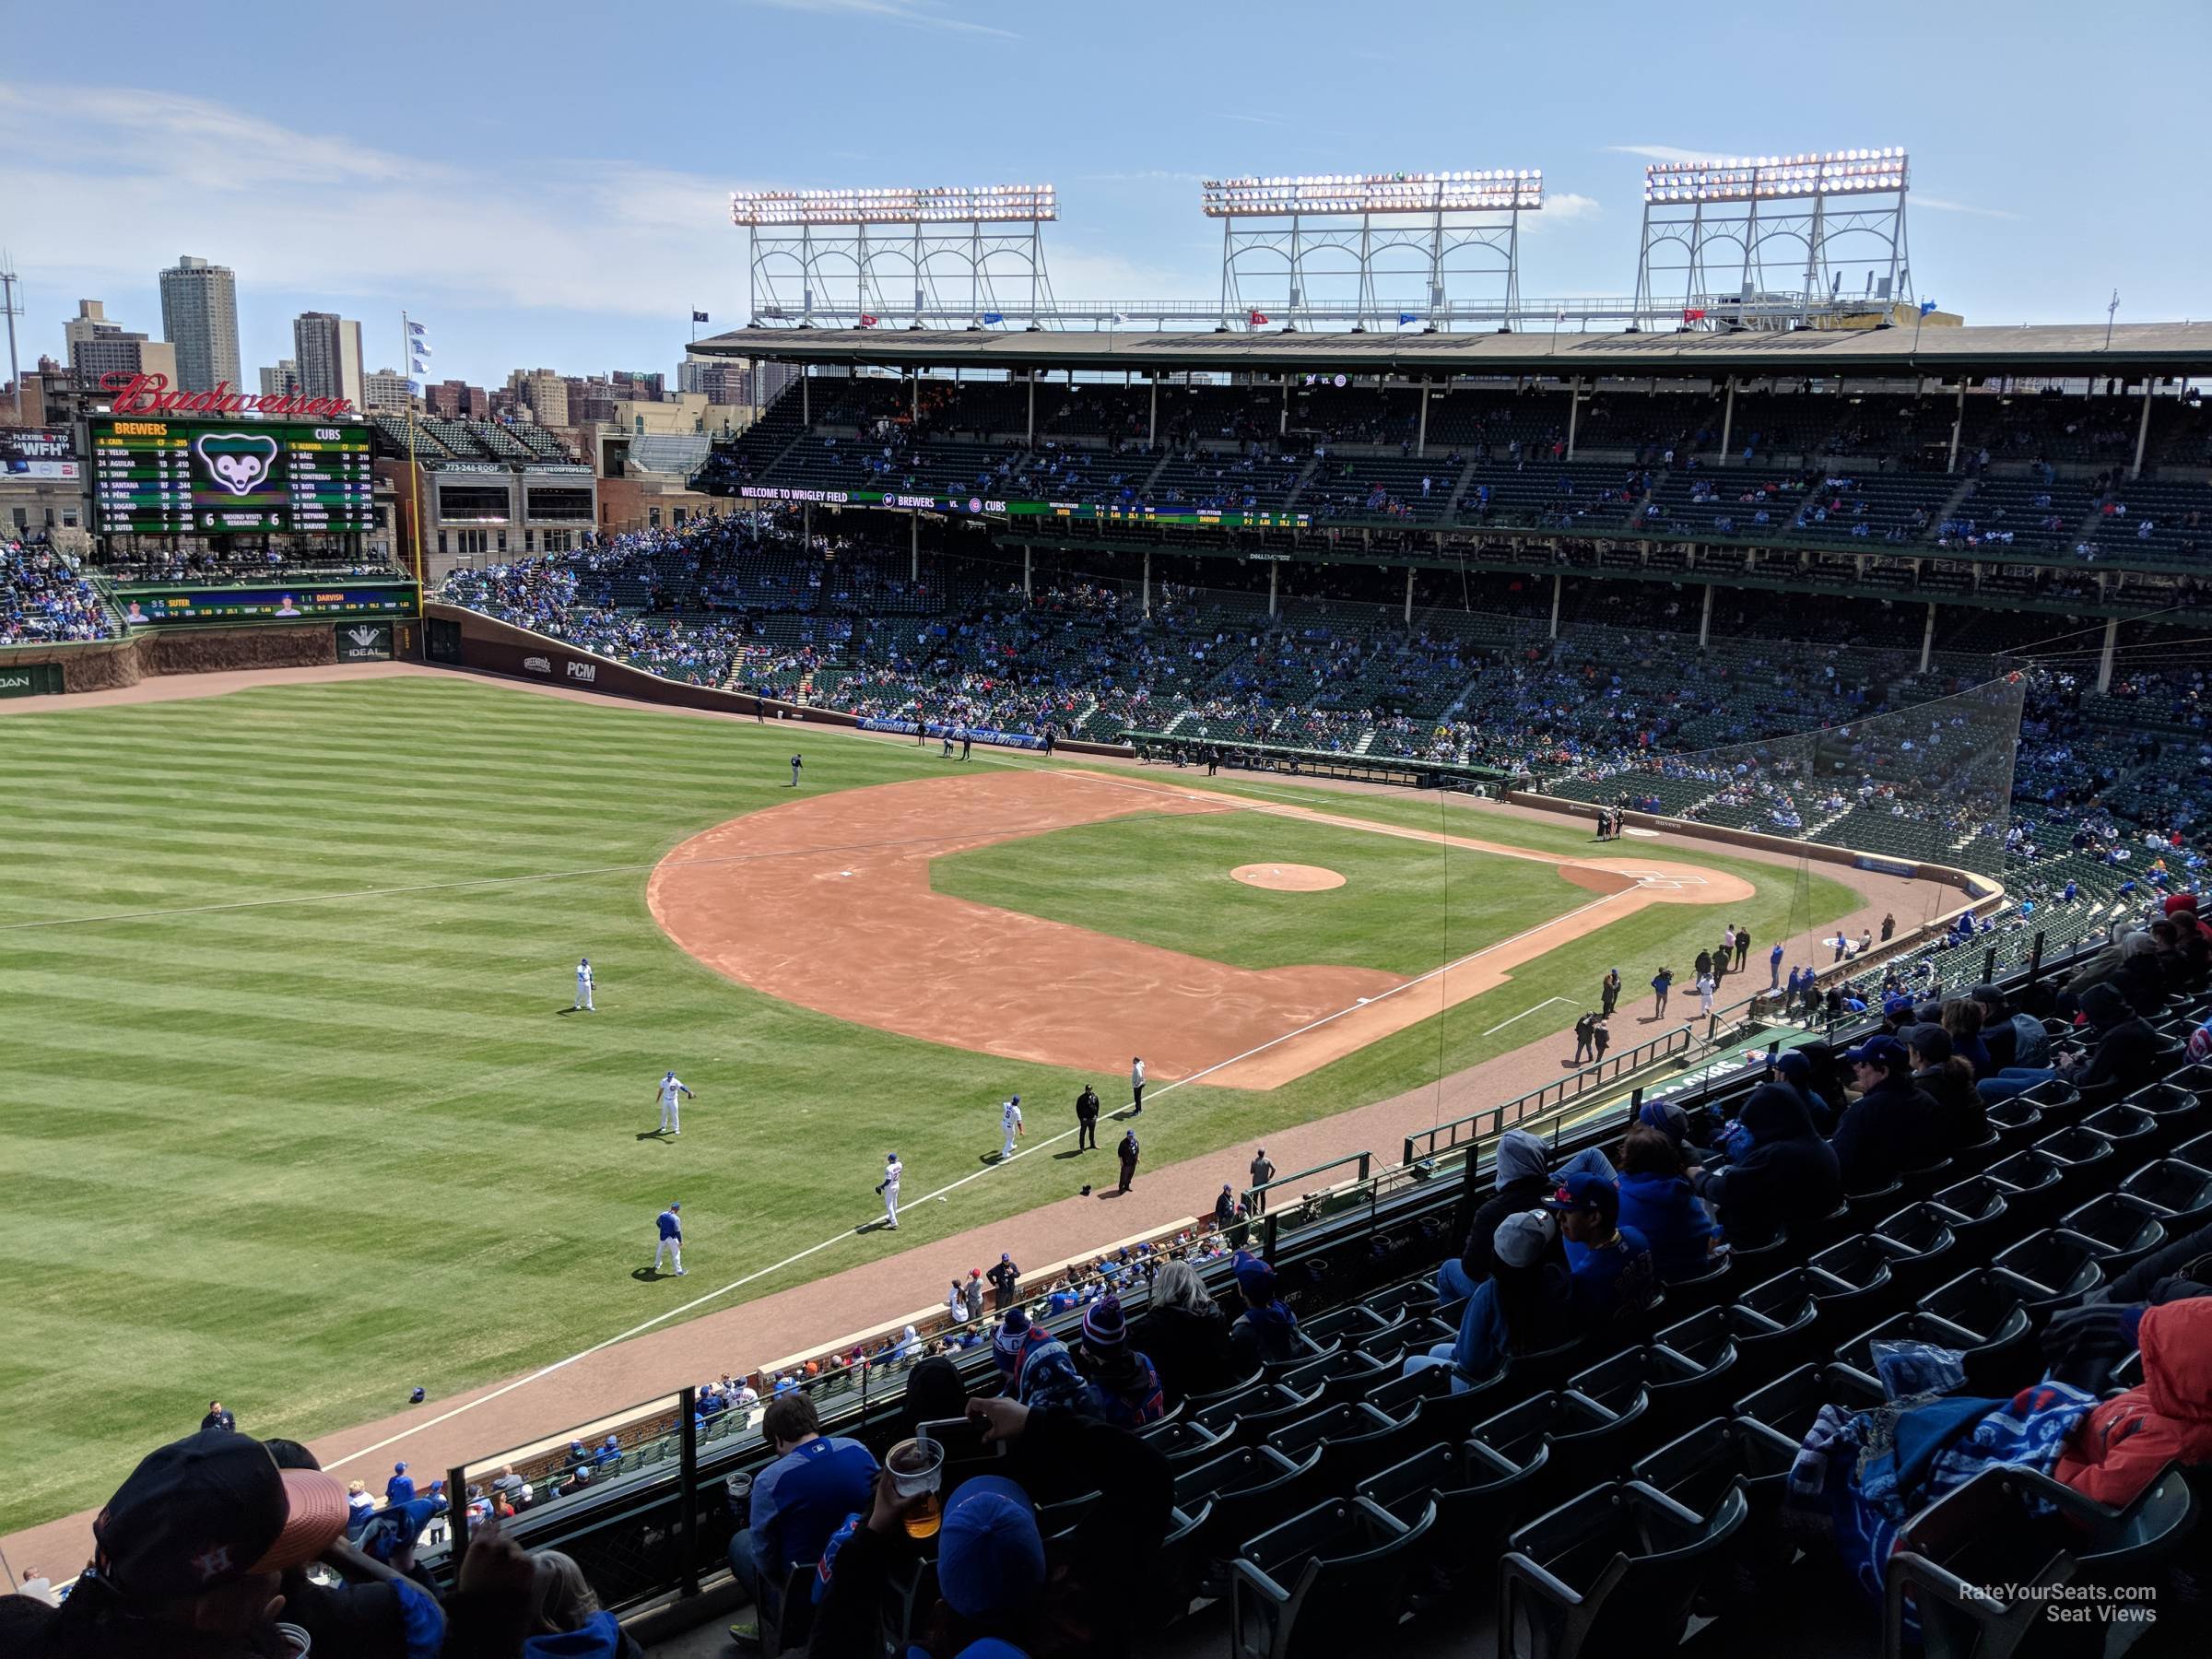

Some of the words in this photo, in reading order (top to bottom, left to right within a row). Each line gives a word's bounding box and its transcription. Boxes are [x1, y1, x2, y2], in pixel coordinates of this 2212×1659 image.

[99, 371, 353, 415] Budweiser
[114, 422, 168, 436] BREWERS
[314, 429, 341, 440] CUBS
[58, 434, 68, 442] TO
[445, 464, 500, 472] 773-248-ROOF
[525, 465, 592, 474] WRIGLEYROOFTOPS.COM
[741, 487, 779, 499] WELCOME
[779, 488, 790, 499] TO
[791, 490, 827, 501] WRIGLEY
[827, 491, 848, 502] FIELD
[898, 496, 935, 508] BREWERS
[985, 500, 1006, 512] CUBS
[206, 513, 215, 526] 6
[271, 513, 279, 526] 6
[168, 599, 191, 607] SUTER
[316, 594, 344, 602] DARVISH
[349, 647, 380, 657] IDEAL
[567, 661, 596, 679] PCM
[863, 719, 905, 733] Reynolds
[995, 734, 1022, 747] Wrap
[1655, 819, 1681, 829] nuveen
[1005, 1110, 1011, 1119] 5
[1012, 1340, 1019, 1350] C
